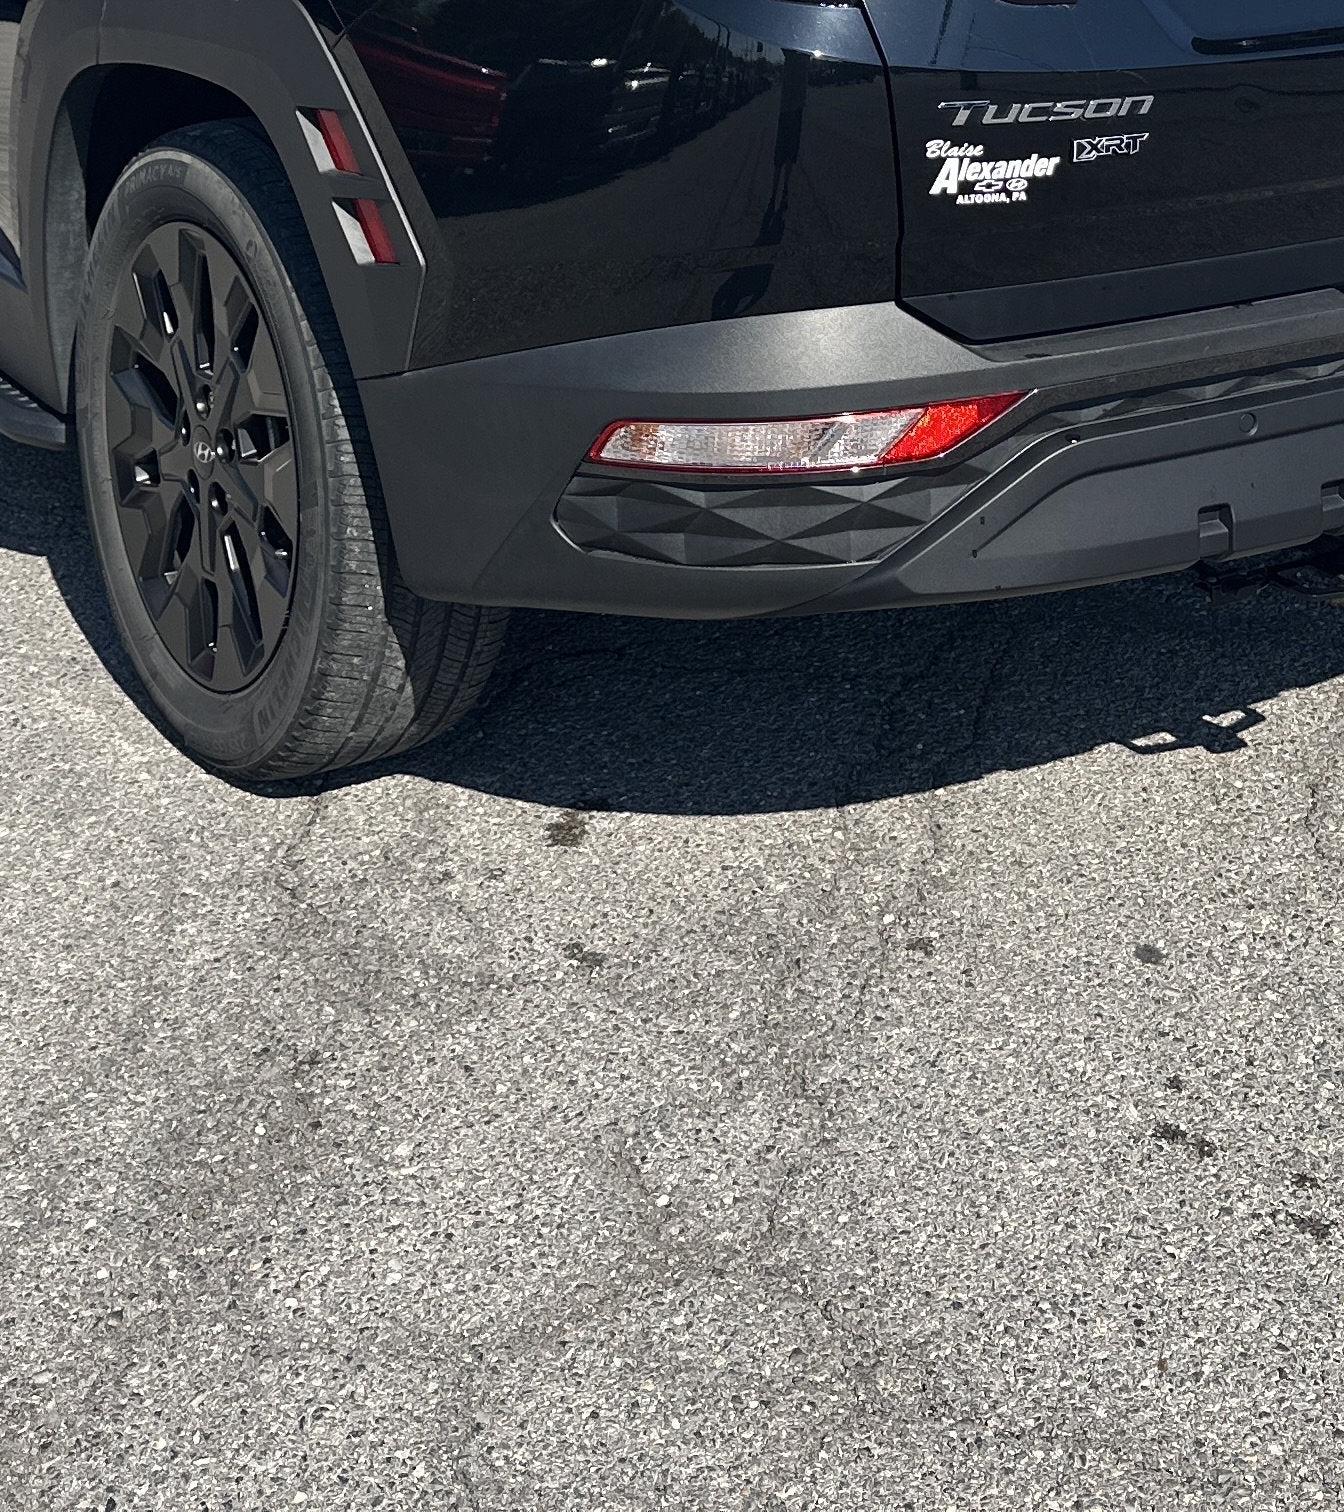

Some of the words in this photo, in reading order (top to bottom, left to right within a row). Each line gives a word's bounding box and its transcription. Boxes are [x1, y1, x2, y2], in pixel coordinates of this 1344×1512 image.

[938, 95, 1155, 127] TUCSON
[925, 139, 984, 158] Blaise
[1078, 132, 1150, 160] XRT
[929, 154, 1060, 195] Alexander
[1012, 191, 1027, 202] PA
